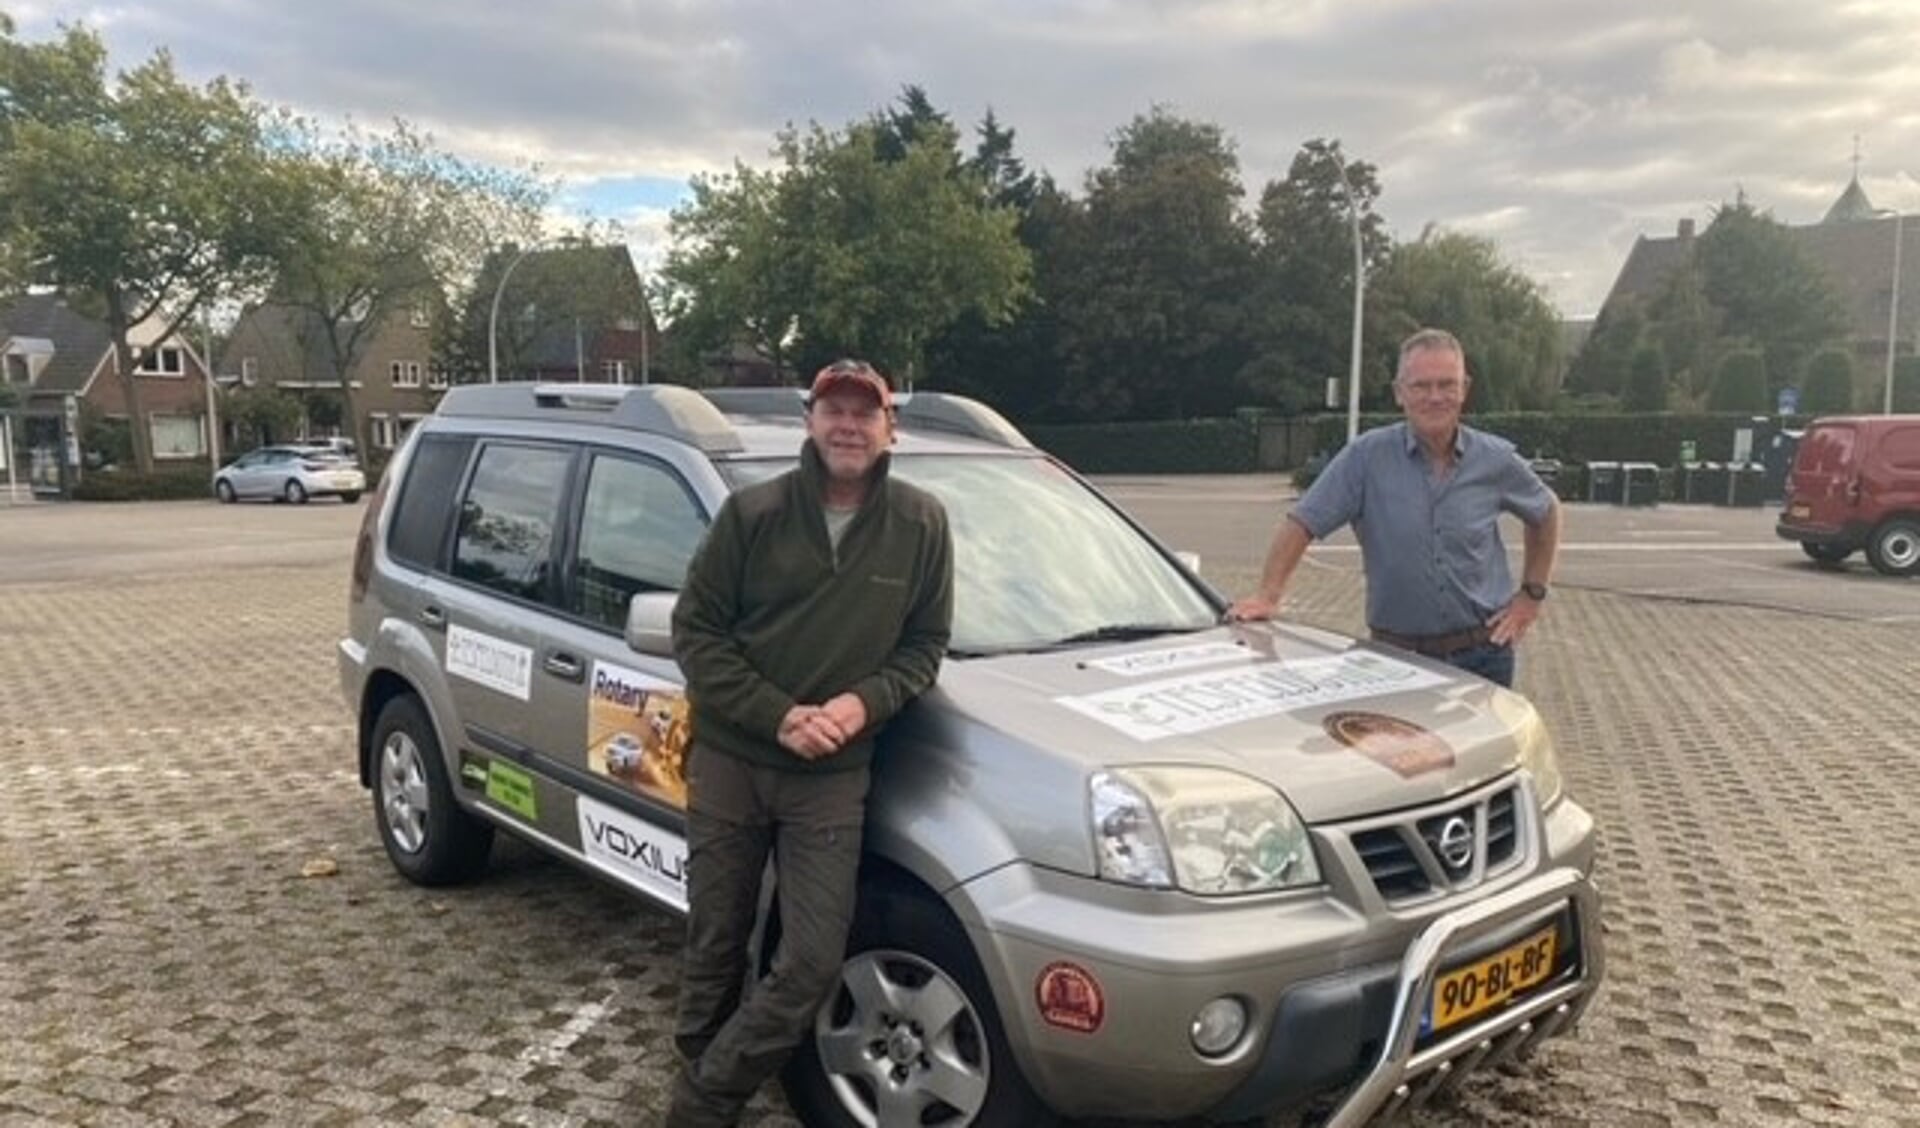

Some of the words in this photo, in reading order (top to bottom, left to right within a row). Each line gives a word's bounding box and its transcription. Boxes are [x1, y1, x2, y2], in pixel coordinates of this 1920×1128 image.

[593, 669, 648, 717] Rotary
[585, 814, 689, 885] VOXIU
[1442, 938, 1549, 1017] 90-BL-BF
